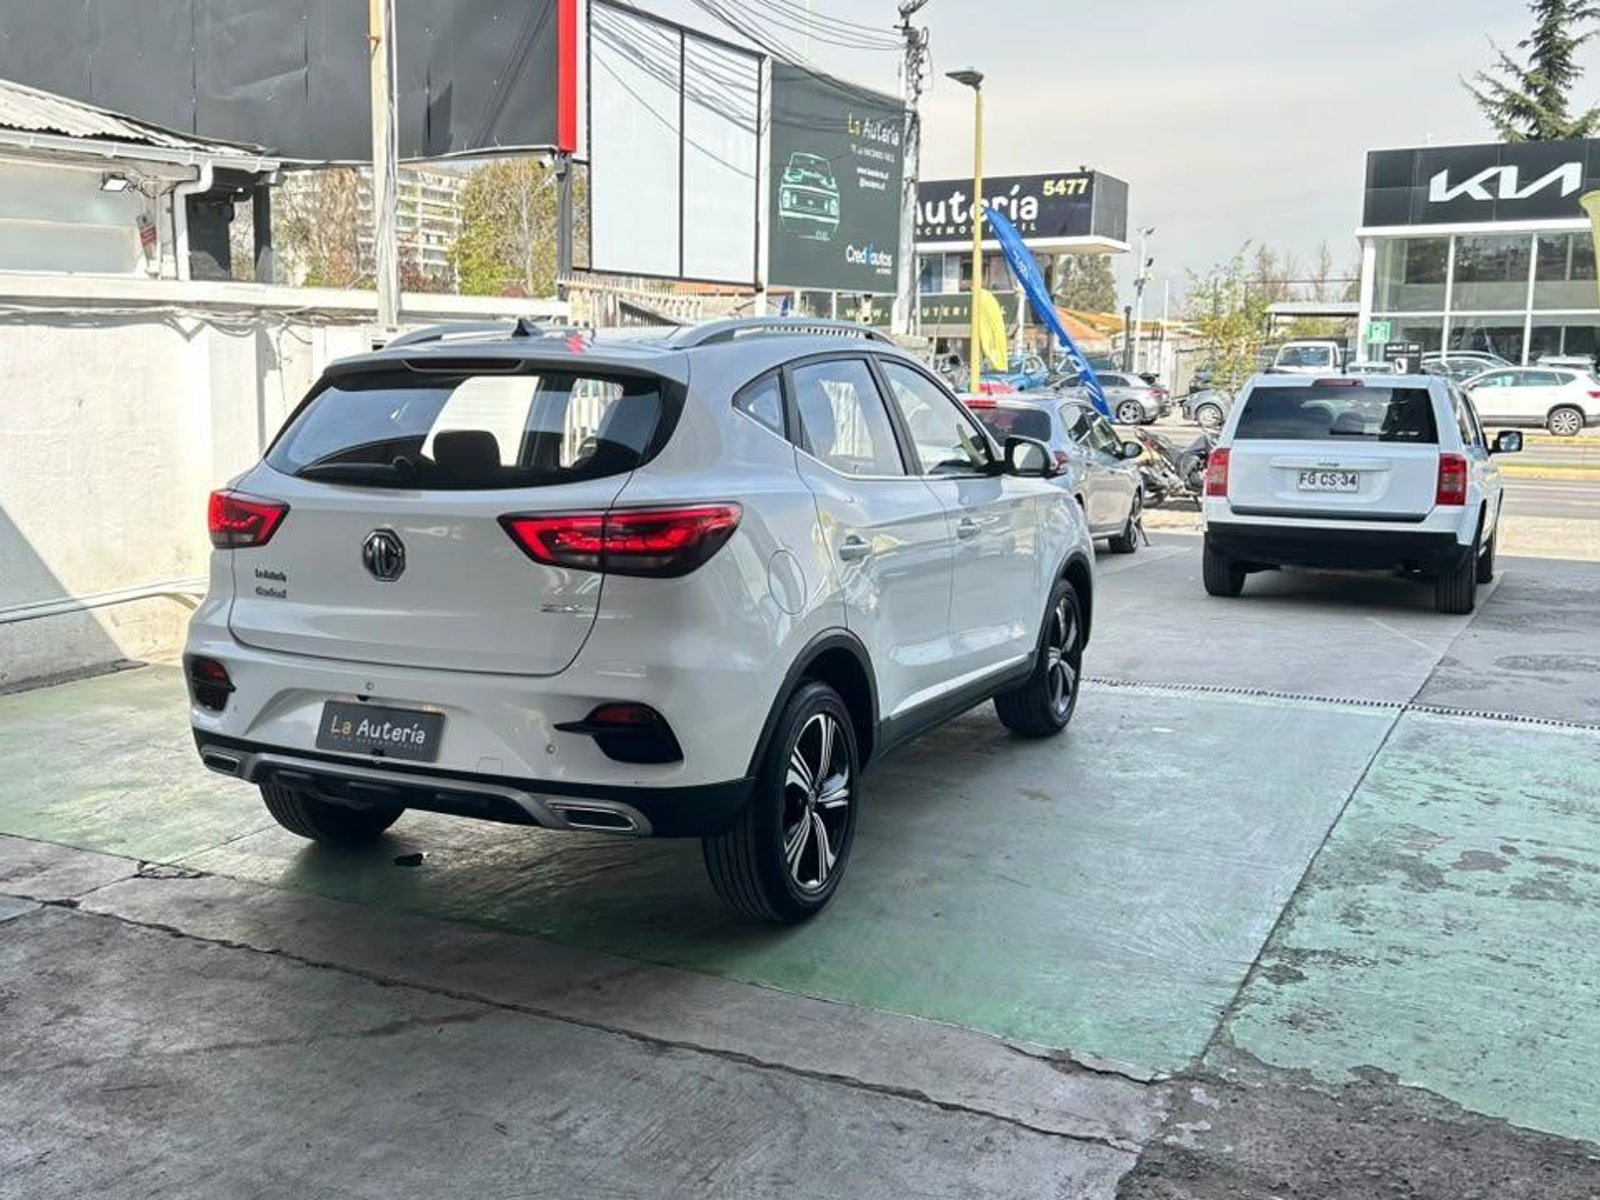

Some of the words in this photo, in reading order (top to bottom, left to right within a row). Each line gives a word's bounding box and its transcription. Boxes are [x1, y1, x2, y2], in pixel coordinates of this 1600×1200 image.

[1042, 178, 1089, 196] 5477
[1429, 162, 1583, 202] KIA
[330, 715, 353, 735] La
[356, 718, 426, 745] Autería
